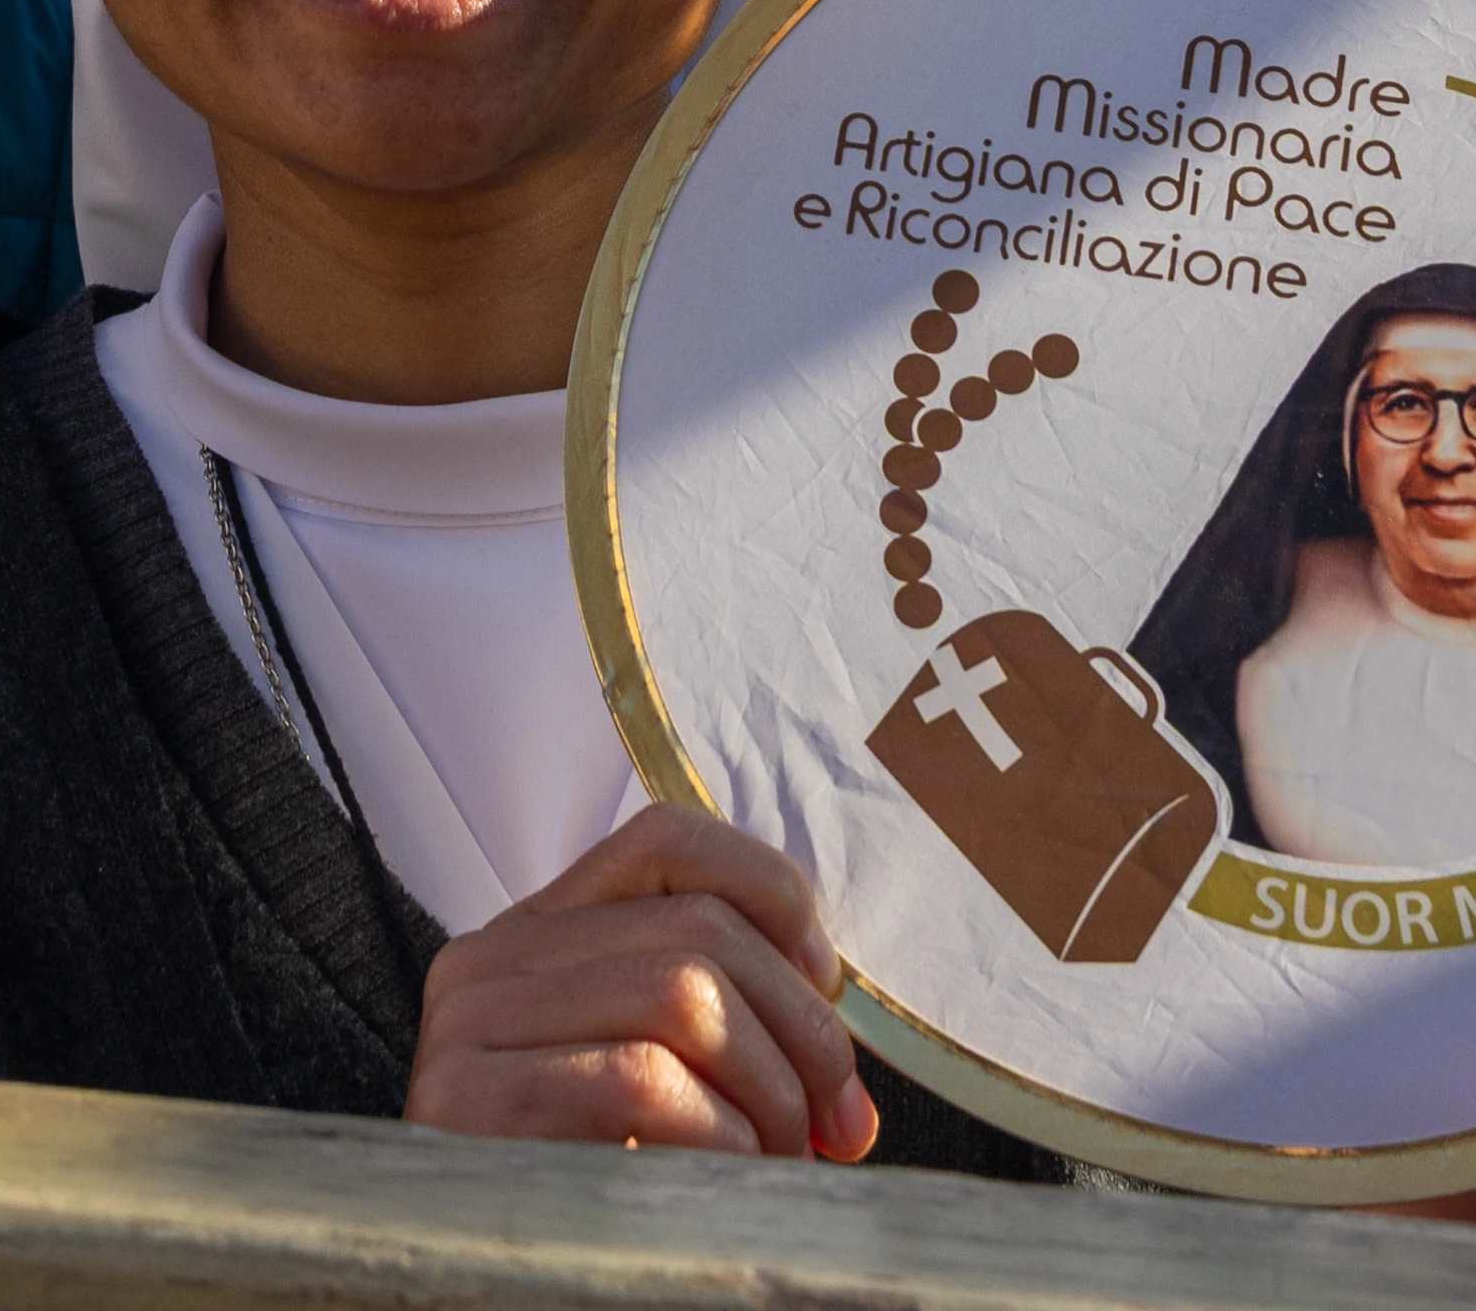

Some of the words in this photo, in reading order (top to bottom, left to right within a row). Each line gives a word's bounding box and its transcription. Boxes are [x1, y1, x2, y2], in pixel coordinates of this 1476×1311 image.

[1027, 74, 1402, 180] Missionaria
[1181, 35, 1410, 117] Madre
[834, 112, 1123, 206] Artigiana
[1145, 158, 1203, 215] di
[1226, 166, 1396, 242] Pace
[793, 194, 832, 229] e
[846, 181, 1307, 299] Riconciliazione
[1250, 877, 1440, 946] SUOR
